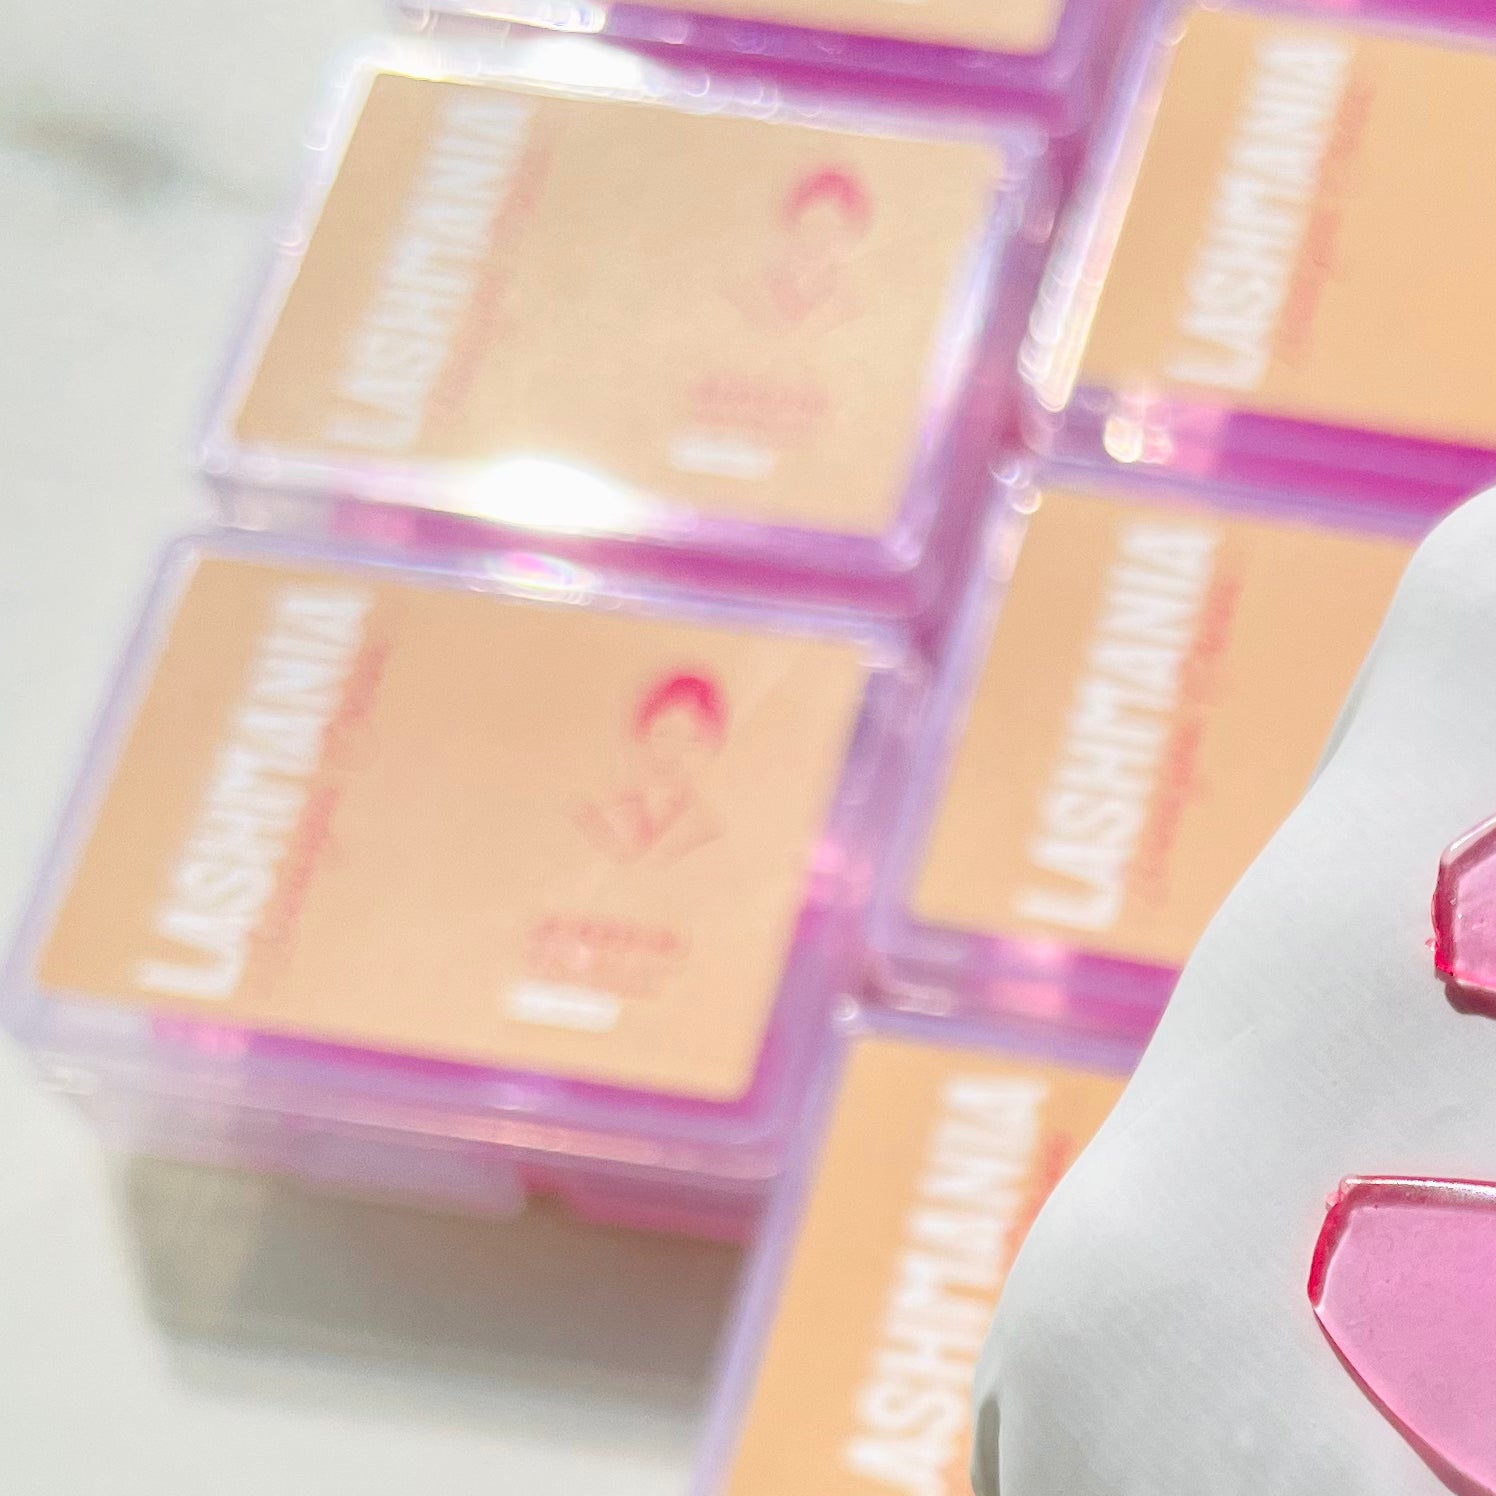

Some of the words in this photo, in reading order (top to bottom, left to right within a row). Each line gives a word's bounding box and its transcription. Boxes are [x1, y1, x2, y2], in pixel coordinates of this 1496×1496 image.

[1165, 34, 1354, 392] LASHMANIA
[135, 586, 376, 1000] LASHMANIA
[1012, 522, 1222, 930] LASHMANIA
